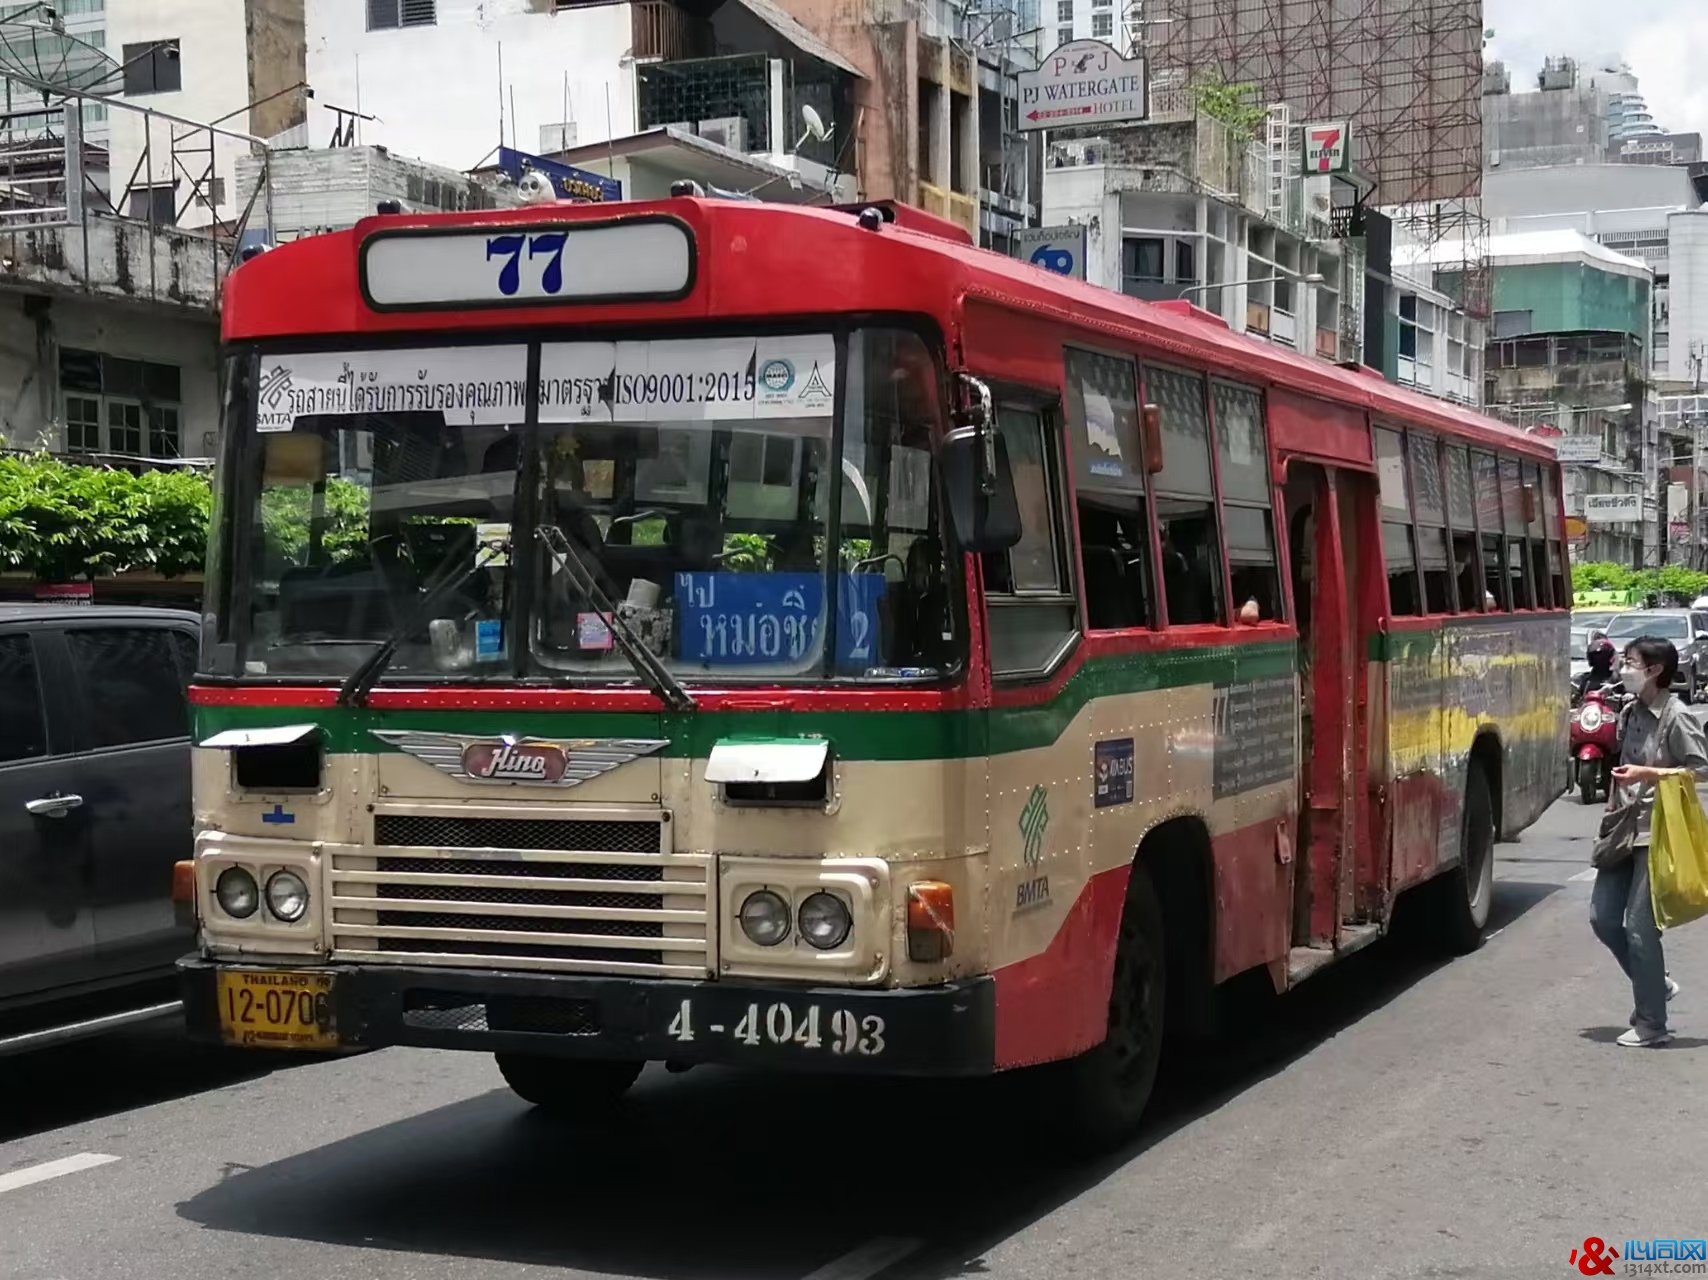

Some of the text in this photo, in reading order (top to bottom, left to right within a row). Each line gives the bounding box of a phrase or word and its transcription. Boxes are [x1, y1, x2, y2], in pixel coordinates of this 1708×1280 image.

[1054, 51, 1109, 77] P J
[1023, 75, 1140, 104] PJ WATERGATE
[1094, 99, 1137, 115] HOTEL
[1311, 129, 1340, 172] 7
[486, 231, 570, 296] 77
[849, 611, 870, 658] 2
[481, 745, 547, 778] Hino
[1016, 875, 1050, 907] BMTA
